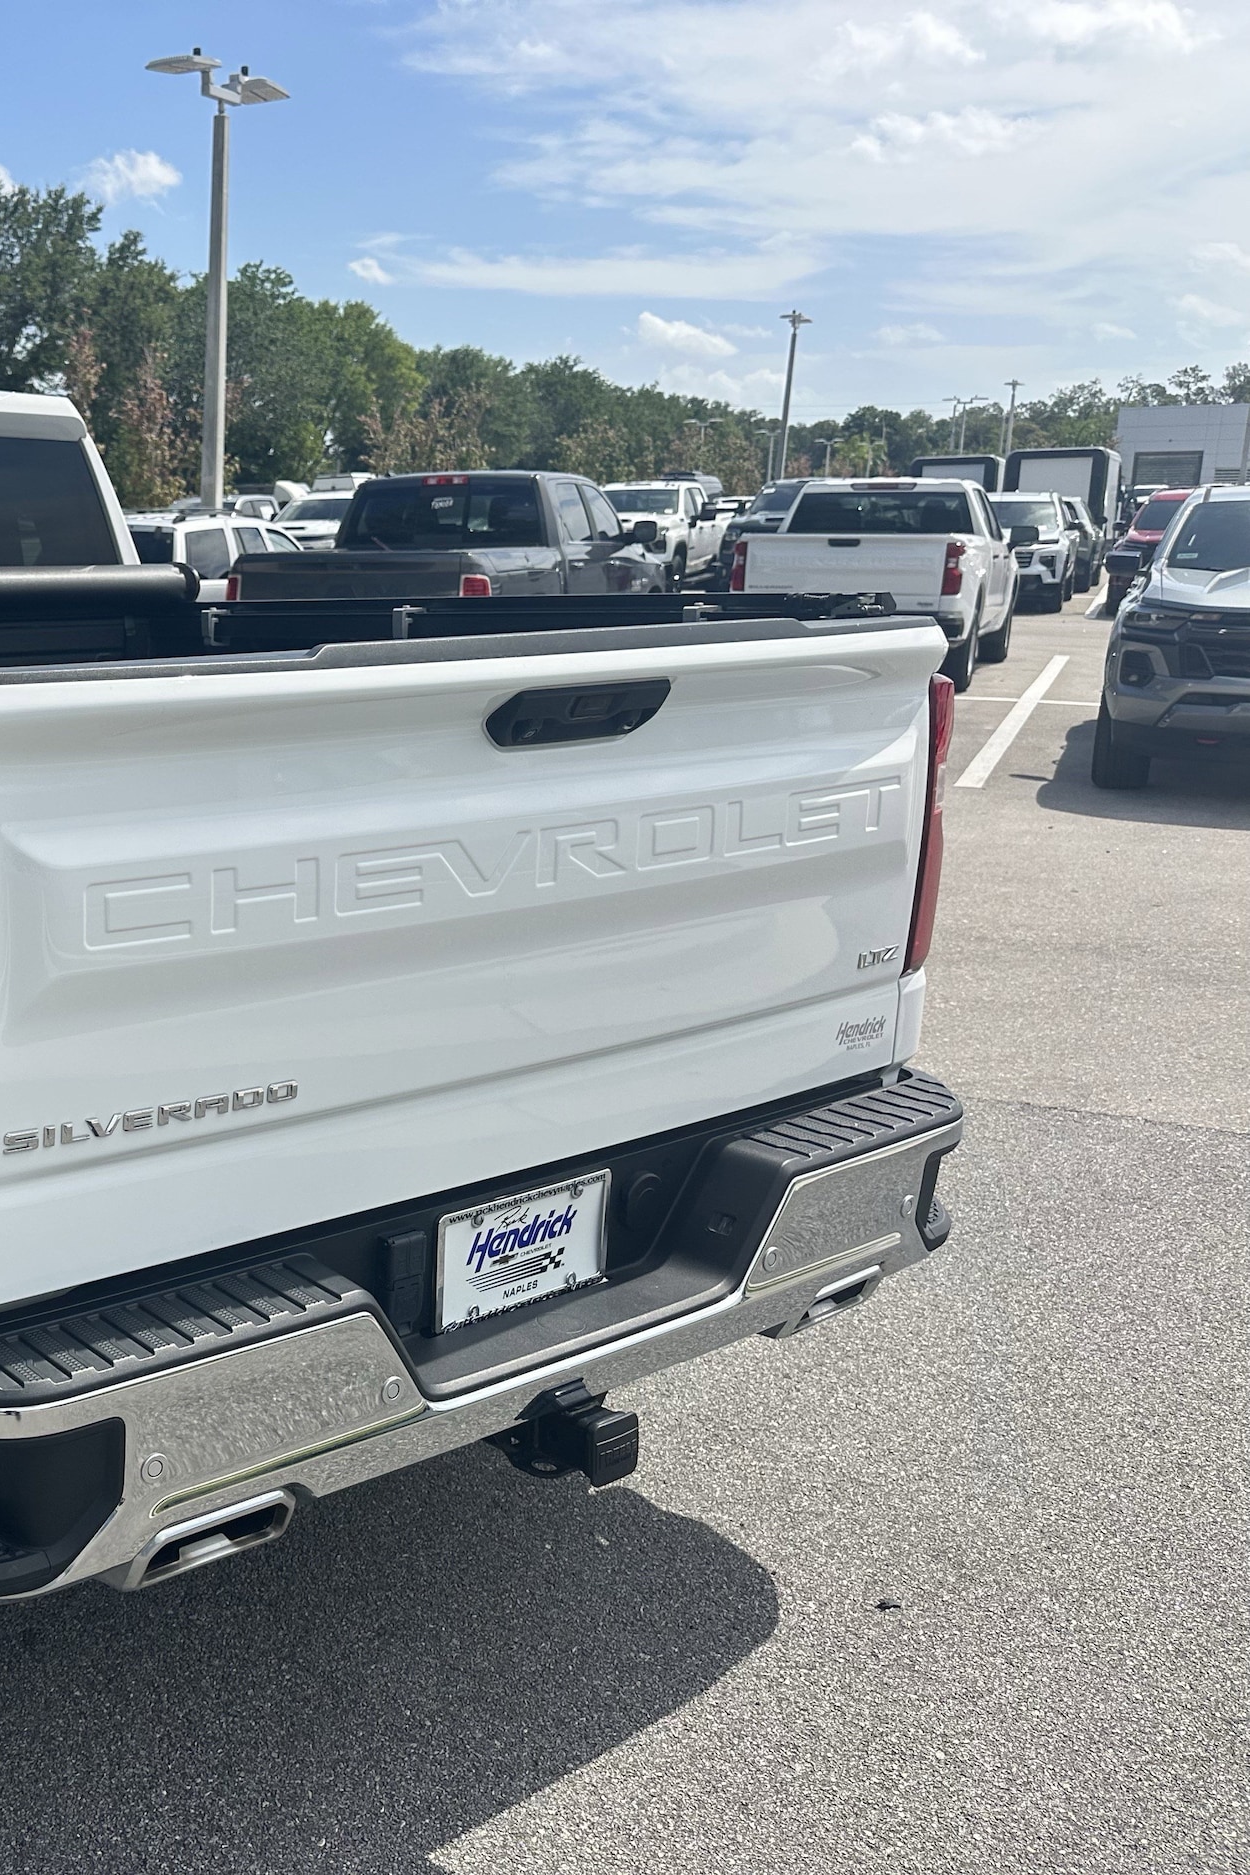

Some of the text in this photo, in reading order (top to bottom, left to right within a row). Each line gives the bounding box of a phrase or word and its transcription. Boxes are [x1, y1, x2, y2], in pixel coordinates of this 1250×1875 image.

[83, 774, 901, 951] CHEVROLET
[857, 944, 899, 969] LTZ
[835, 1015, 886, 1045] Hendrick
[843, 1032, 883, 1045] CHEVROLET
[2, 1079, 299, 1155] SILVERADO
[466, 1204, 578, 1273] Hendrick
[520, 1243, 552, 1257] CHEVROLET
[503, 1280, 538, 1299] NAPLES
